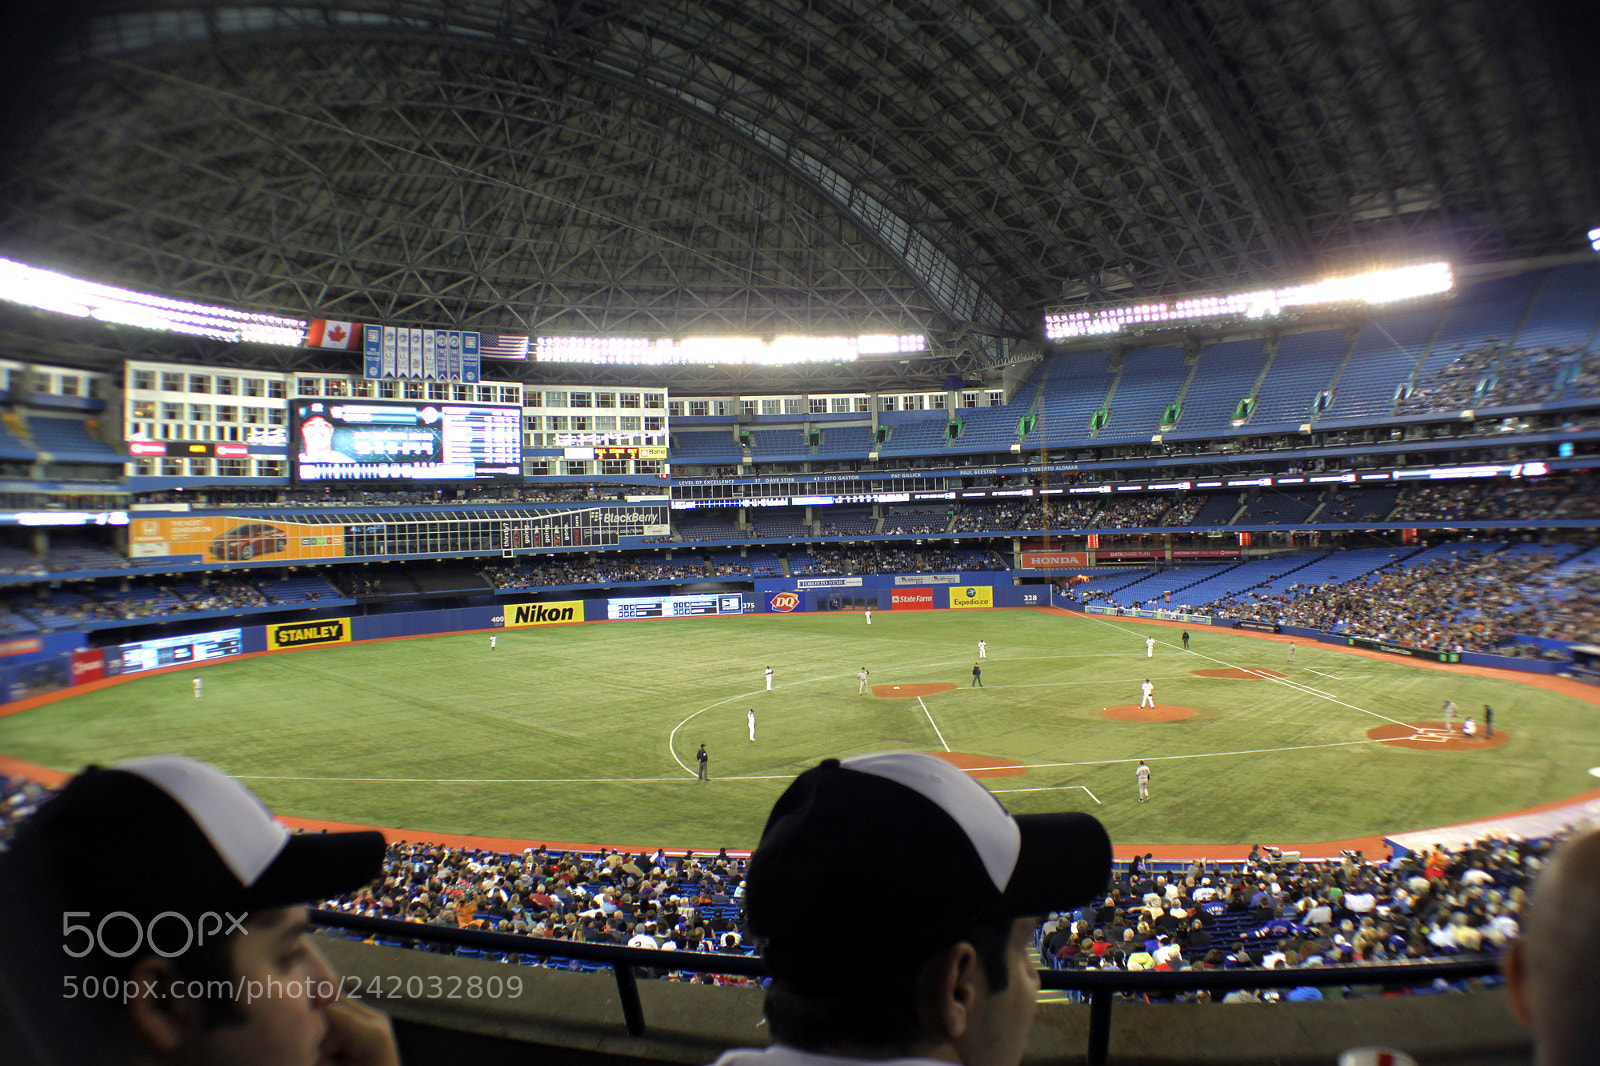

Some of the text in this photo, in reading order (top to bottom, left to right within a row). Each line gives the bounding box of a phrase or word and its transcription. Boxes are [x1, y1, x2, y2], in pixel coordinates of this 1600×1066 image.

[603, 512, 658, 524] BlackBerry
[502, 522, 510, 547] thirsty?
[1030, 556, 1080, 564] HONDA
[776, 597, 795, 608] DQ
[900, 595, 916, 603] State
[515, 605, 574, 624] Nikon
[278, 625, 339, 643] STANLEY
